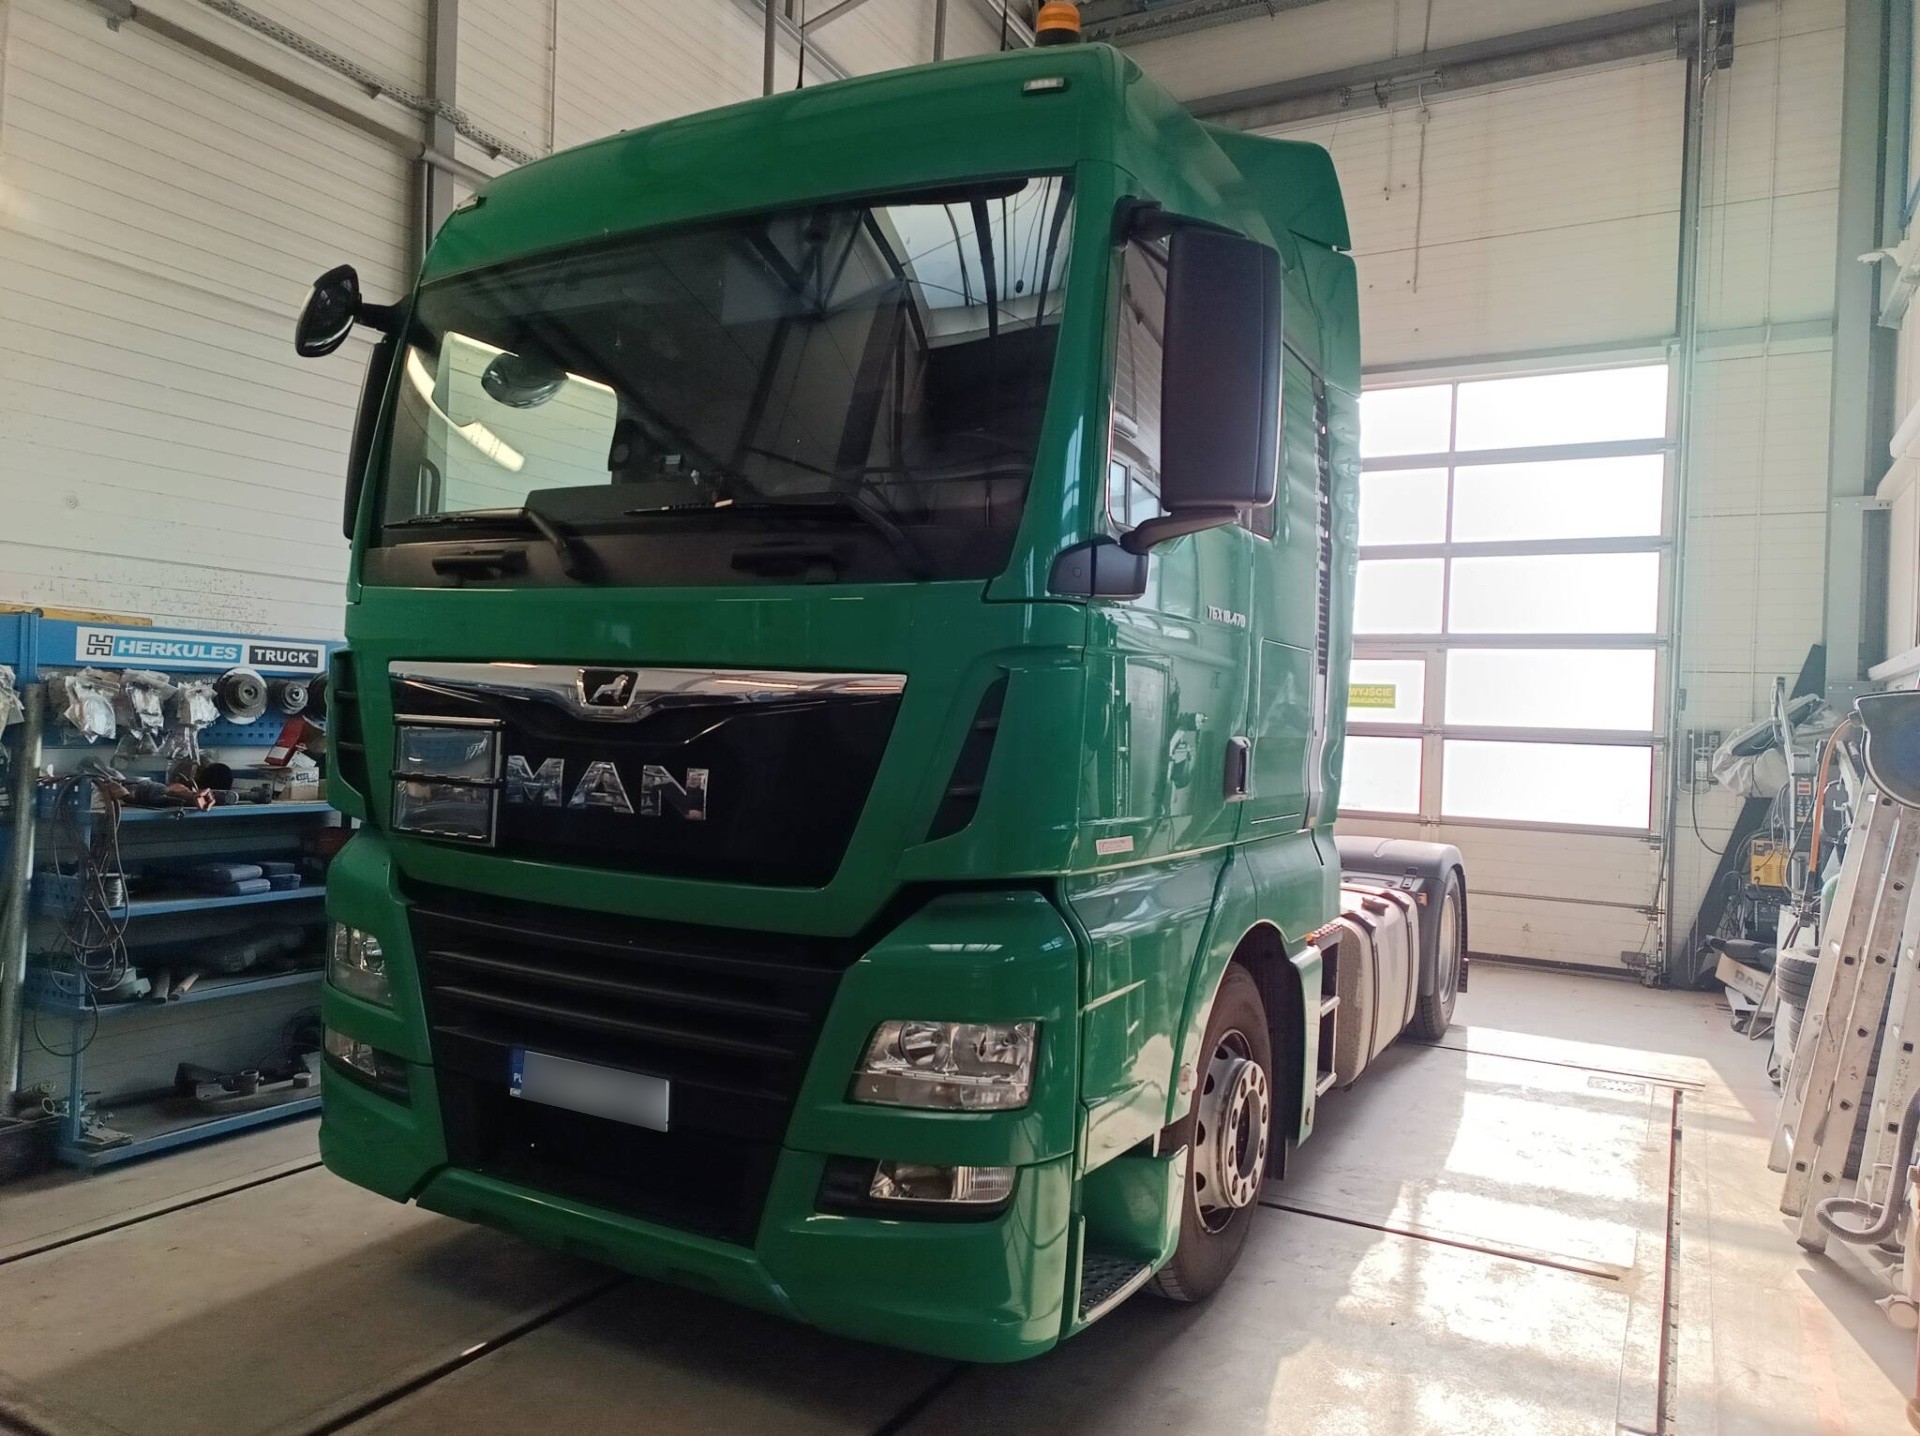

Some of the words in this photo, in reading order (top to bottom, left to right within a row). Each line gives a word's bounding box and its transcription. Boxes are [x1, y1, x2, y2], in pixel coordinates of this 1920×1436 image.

[118, 640, 237, 660] HERKULES
[254, 648, 309, 664] TRUCK
[506, 755, 709, 820] MAN
